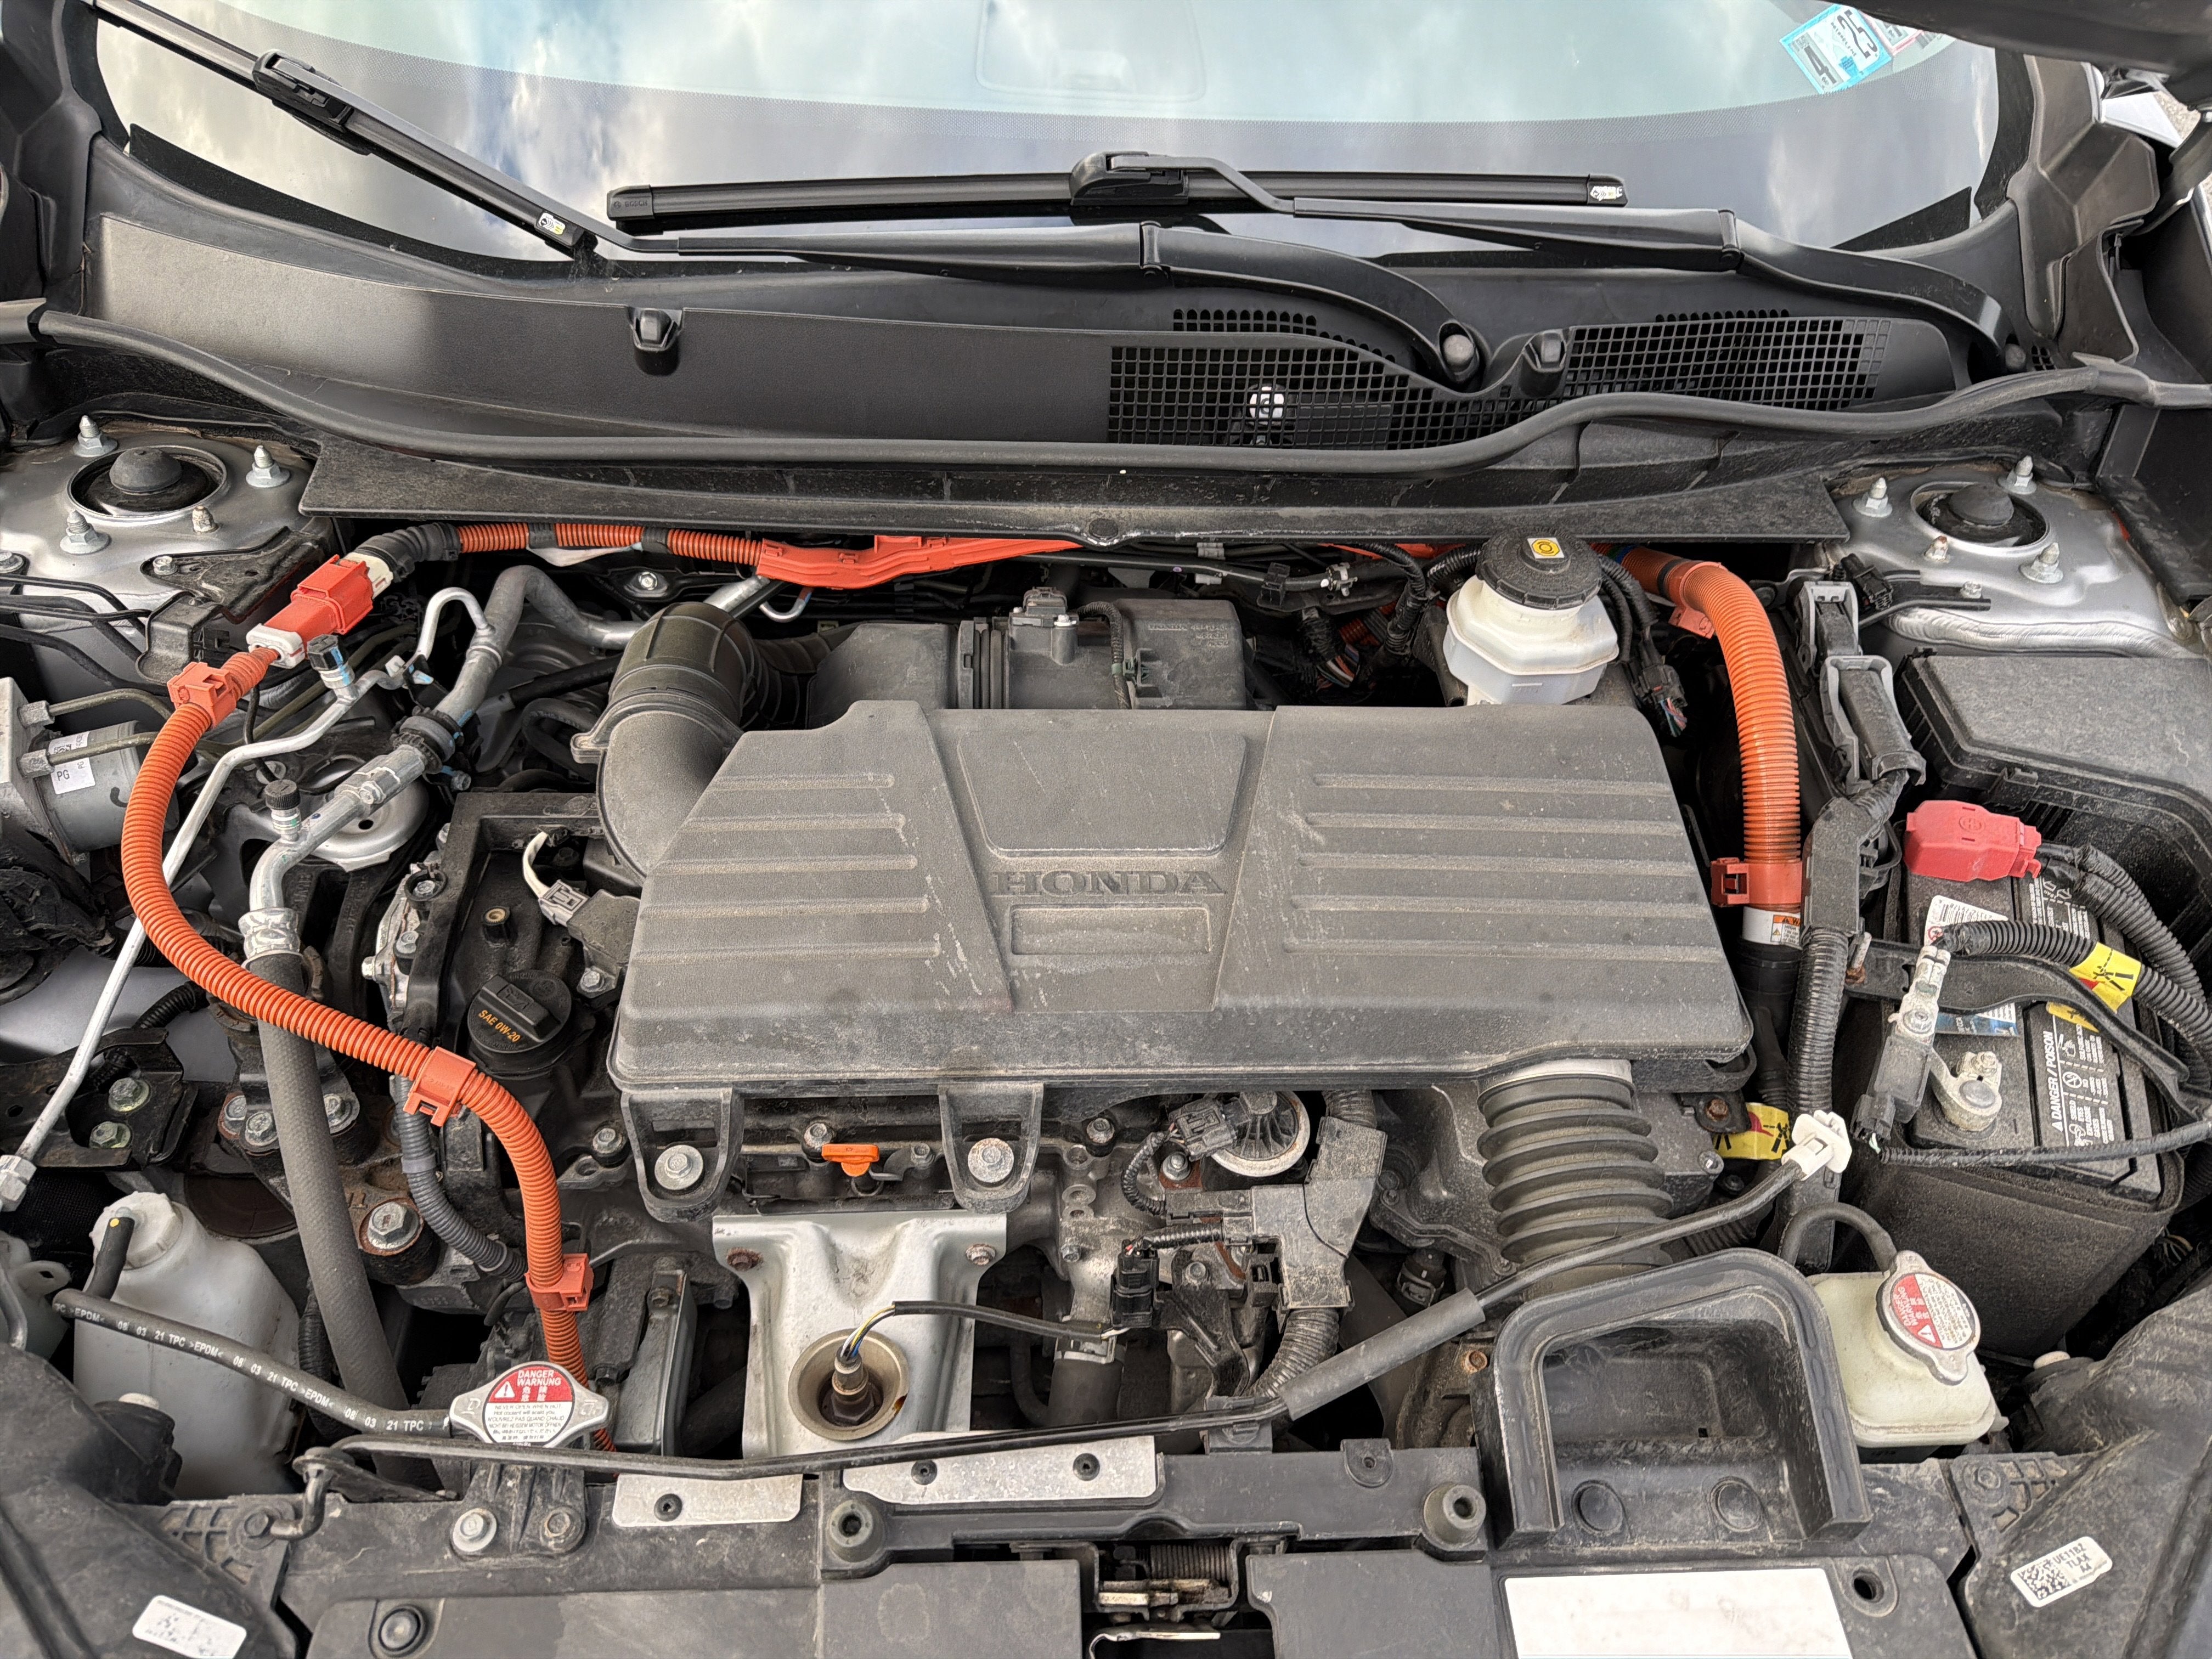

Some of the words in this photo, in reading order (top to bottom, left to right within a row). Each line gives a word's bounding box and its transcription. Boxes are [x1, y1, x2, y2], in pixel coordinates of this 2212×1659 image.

[1837, 9, 1878, 58] 25
[1804, 46, 1836, 83] 4
[57, 769, 70, 782] PG
[989, 870, 1227, 897] HONDA
[478, 1009, 499, 1026] SAE
[495, 1022, 521, 1042] 0W-20
[2042, 1030, 2057, 1068] POISON
[2048, 1076, 2063, 1120] DANGER
[136, 1326, 147, 1337] 03
[154, 1330, 165, 1341] 21
[168, 1334, 186, 1347] TPC
[233, 1356, 245, 1368] 08
[250, 1363, 262, 1375] 03
[267, 1372, 279, 1384] 21
[280, 1376, 298, 1392] TPC
[345, 1408, 357, 1420] 08
[364, 1416, 377, 1429] 03
[386, 1420, 398, 1431] 21
[403, 1420, 424, 1432] TPC
[517, 1377, 561, 1387] WARNUNG
[518, 1369, 554, 1379] DANGER
